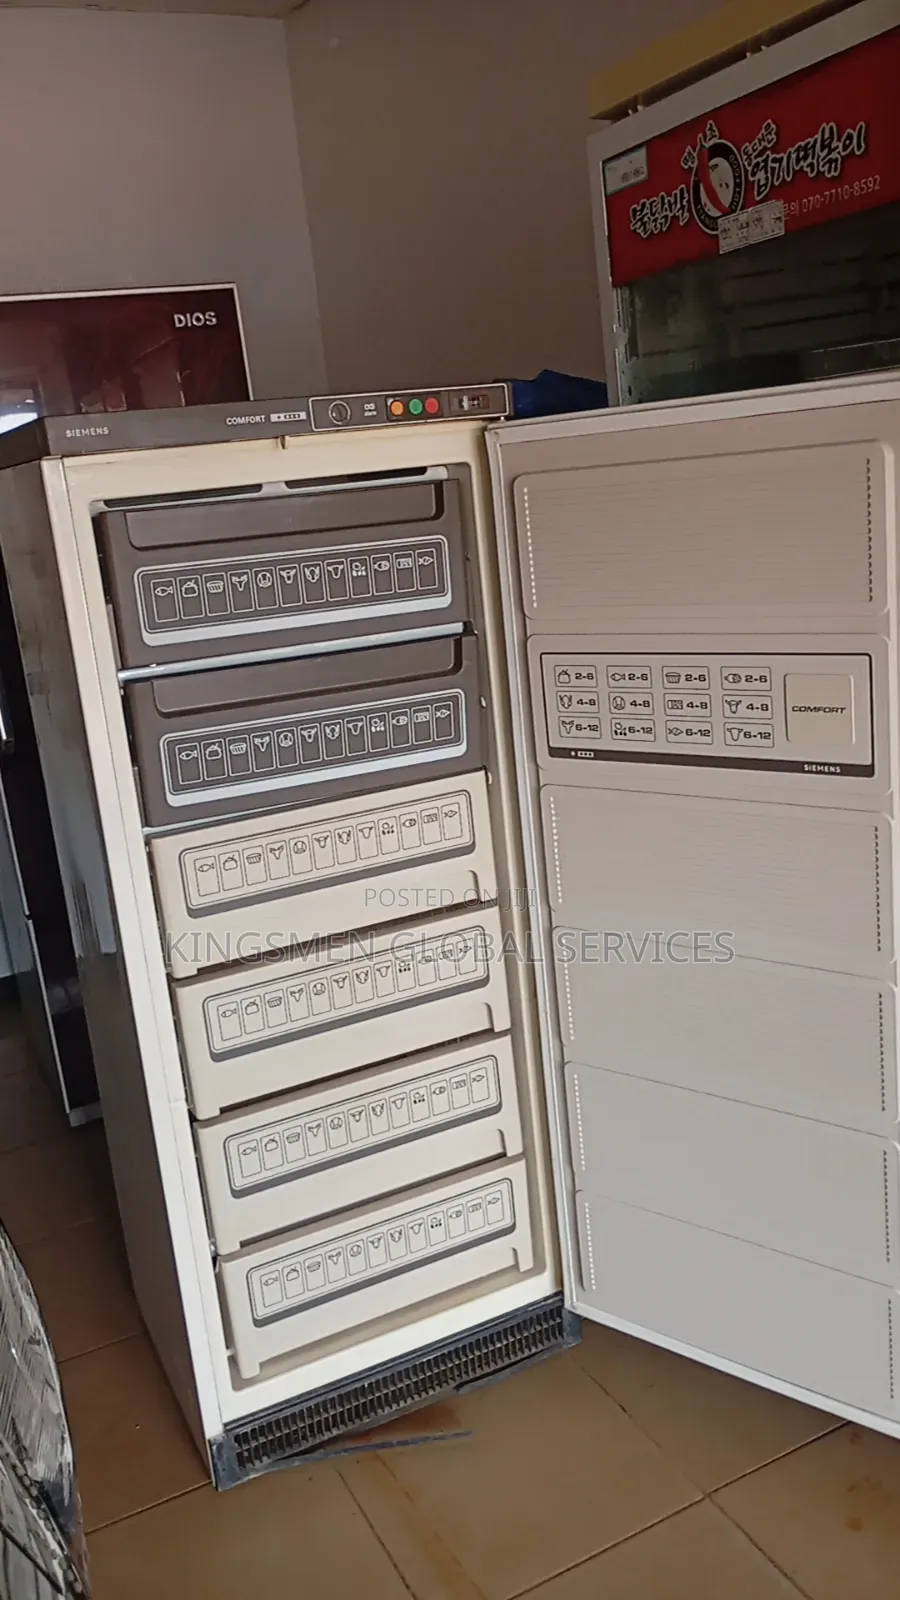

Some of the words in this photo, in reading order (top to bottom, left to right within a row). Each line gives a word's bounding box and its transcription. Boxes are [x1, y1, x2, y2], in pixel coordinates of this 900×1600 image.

[750, 121, 866, 200] 엽기떡볶이
[802, 175, 880, 212] 070-7710-8592
[630, 184, 690, 238] 불닭발
[173, 311, 217, 328] DIOS
[226, 415, 265, 425] COMFORT
[65, 427, 109, 438] SIEMENS
[574, 672, 595, 680] 2-6
[628, 673, 649, 681] 2-6
[684, 674, 707, 682] 2-6
[744, 675, 768, 683] 2-6
[576, 698, 597, 706] 4-8
[629, 700, 651, 708] 4-8
[686, 701, 708, 710] 4-8
[746, 703, 769, 712] 4-8
[791, 705, 847, 714] COMFORT
[575, 723, 599, 732] 6-12
[628, 726, 653, 735] 6-12
[685, 728, 711, 737] 6-12
[743, 731, 772, 740] 6-12
[803, 764, 841, 773] SIEMENS
